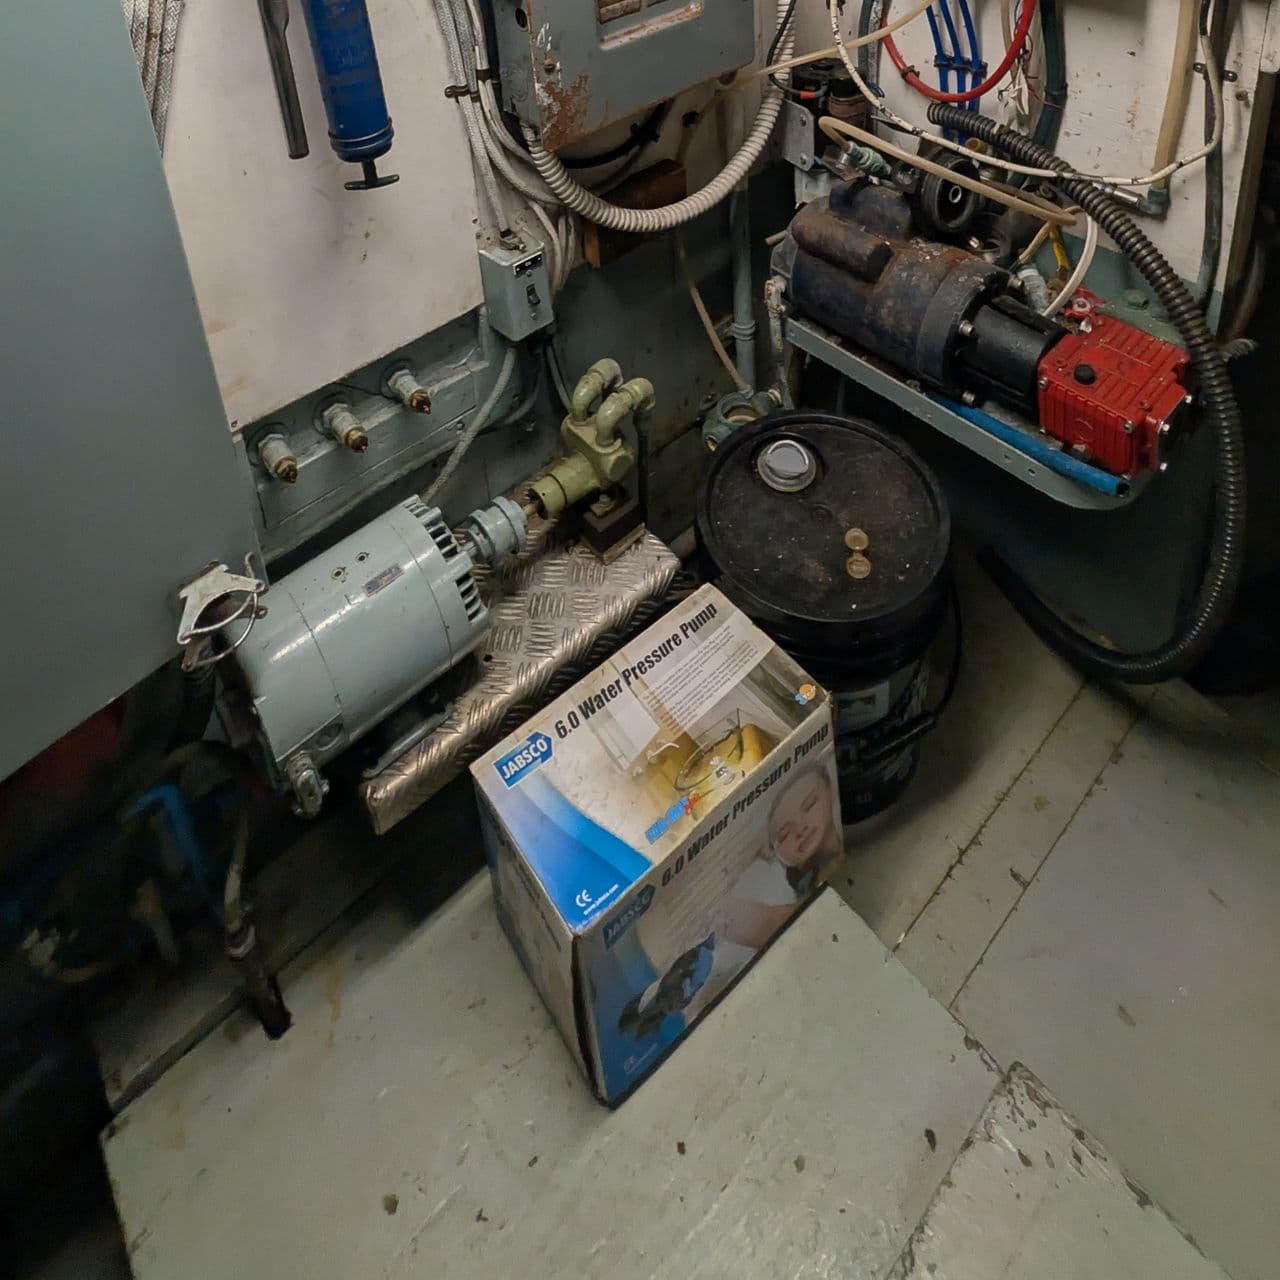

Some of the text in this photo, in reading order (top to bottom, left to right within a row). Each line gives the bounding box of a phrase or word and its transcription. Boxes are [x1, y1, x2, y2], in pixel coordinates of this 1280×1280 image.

[555, 602, 718, 739] 6.0 Water Pressure Pump
[501, 737, 548, 780] JABSCO
[662, 855, 685, 887] 6.0
[687, 813, 730, 863] Water
[733, 756, 792, 821] Pressure
[793, 722, 829, 764] Pump
[575, 888, 592, 907] CE
